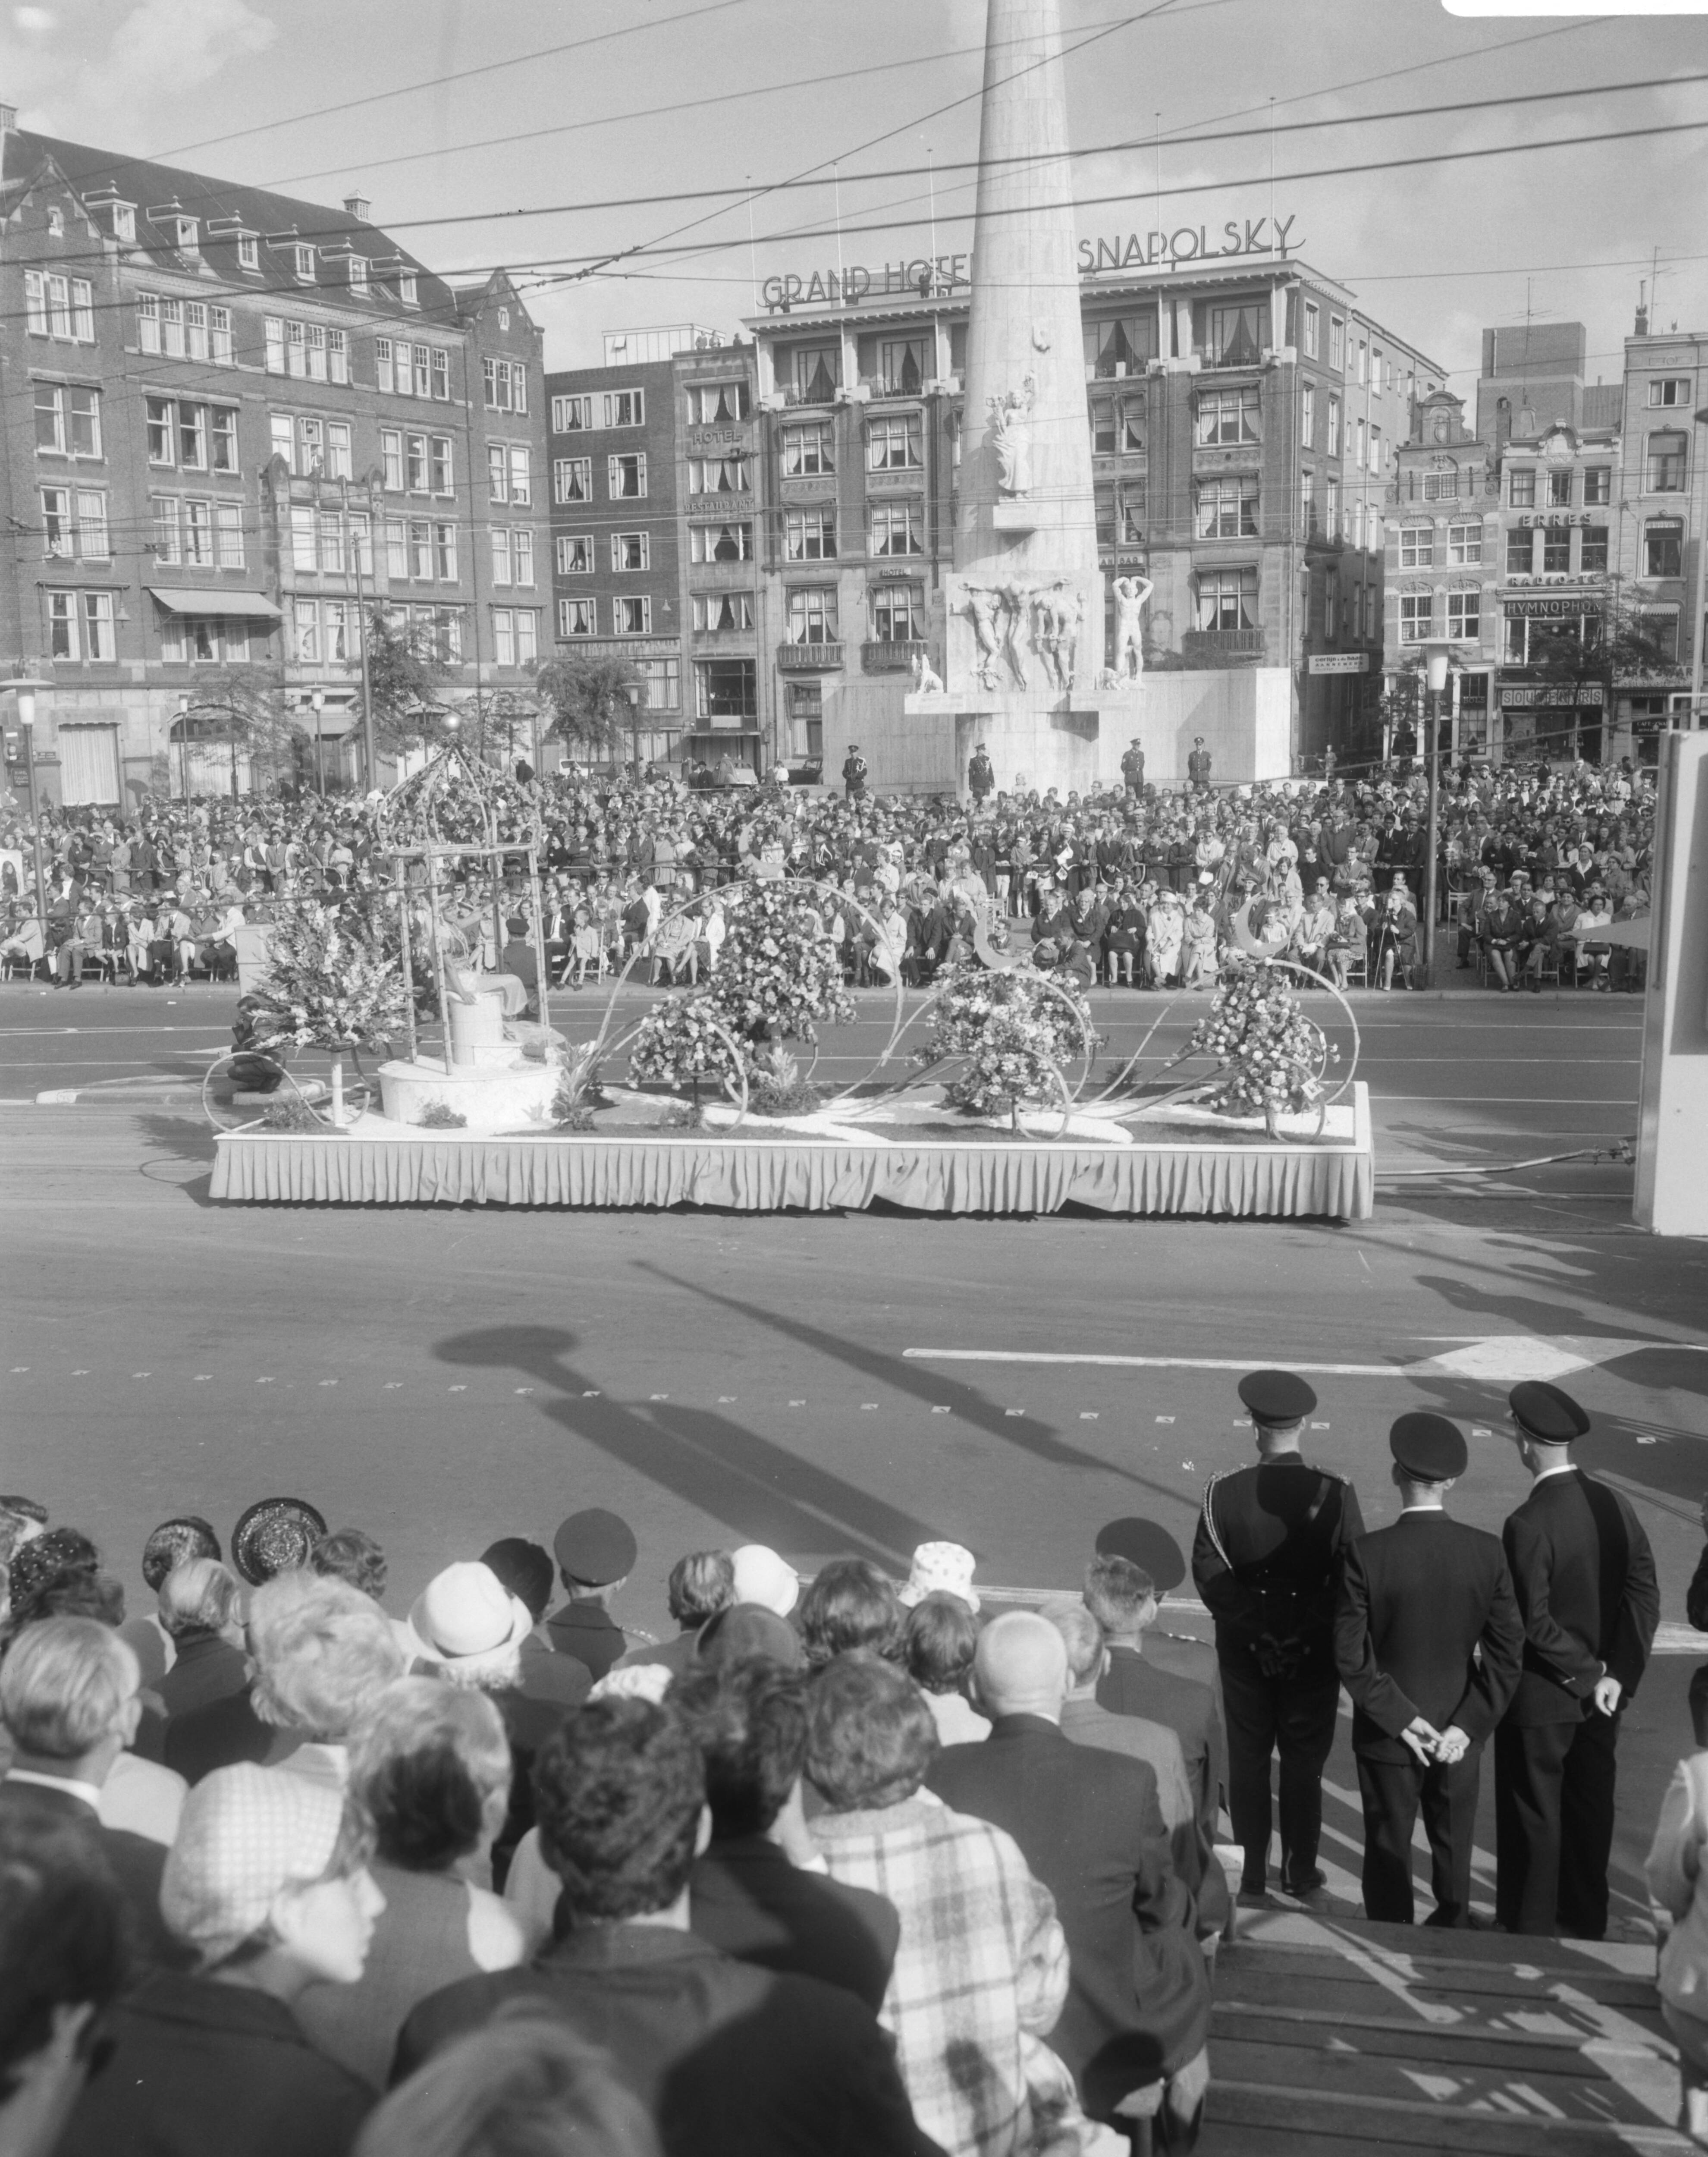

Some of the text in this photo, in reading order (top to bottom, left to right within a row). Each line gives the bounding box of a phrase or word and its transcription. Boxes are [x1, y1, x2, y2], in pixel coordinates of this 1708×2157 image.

[762, 214, 1297, 305] GRAND HOTE SNAPOLSKY
[693, 429, 742, 445] HOTEL
[684, 499, 754, 512] RESTAURANT
[1521, 513, 1592, 527] ERRES
[1655, 667, 1693, 677] ZWAR
[1504, 691, 1601, 704] SOUENRS
